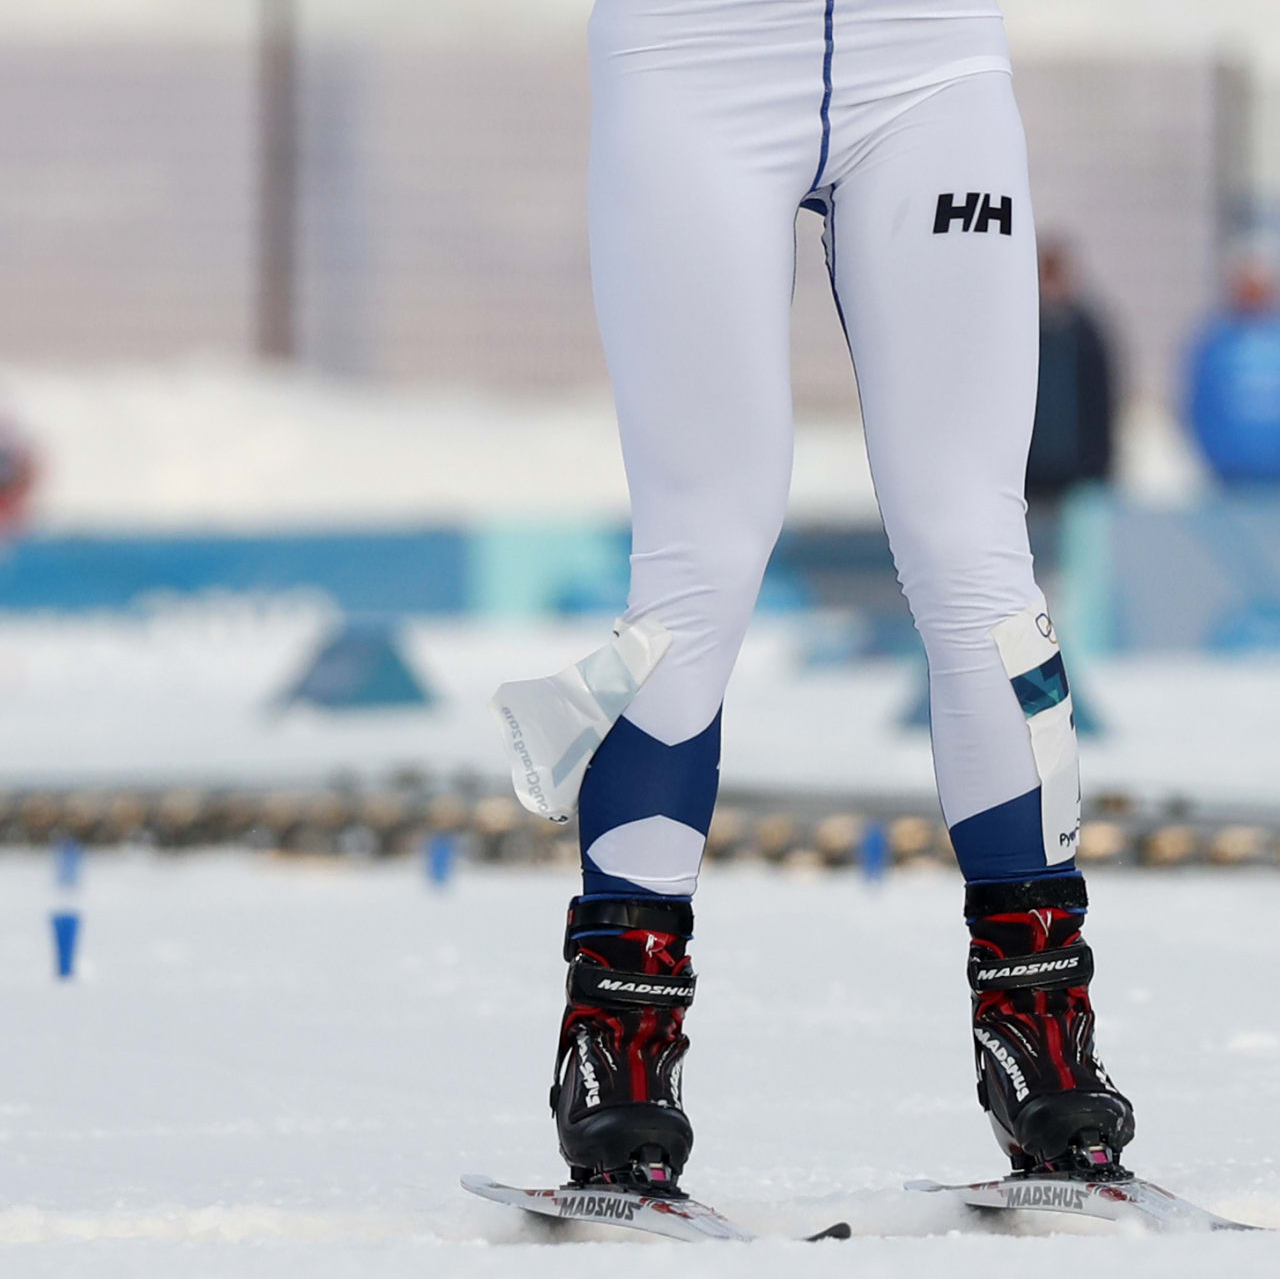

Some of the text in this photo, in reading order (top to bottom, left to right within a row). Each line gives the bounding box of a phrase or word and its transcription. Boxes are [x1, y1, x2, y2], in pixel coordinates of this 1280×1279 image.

[932, 191, 1013, 236] HH
[976, 956, 1080, 982] MADSHUS
[597, 978, 694, 998] MADSHUS
[973, 1026, 1031, 1103] MADSHUS
[558, 1195, 643, 1221] MADSHUS
[1004, 1184, 1090, 1210] MADSHUS
